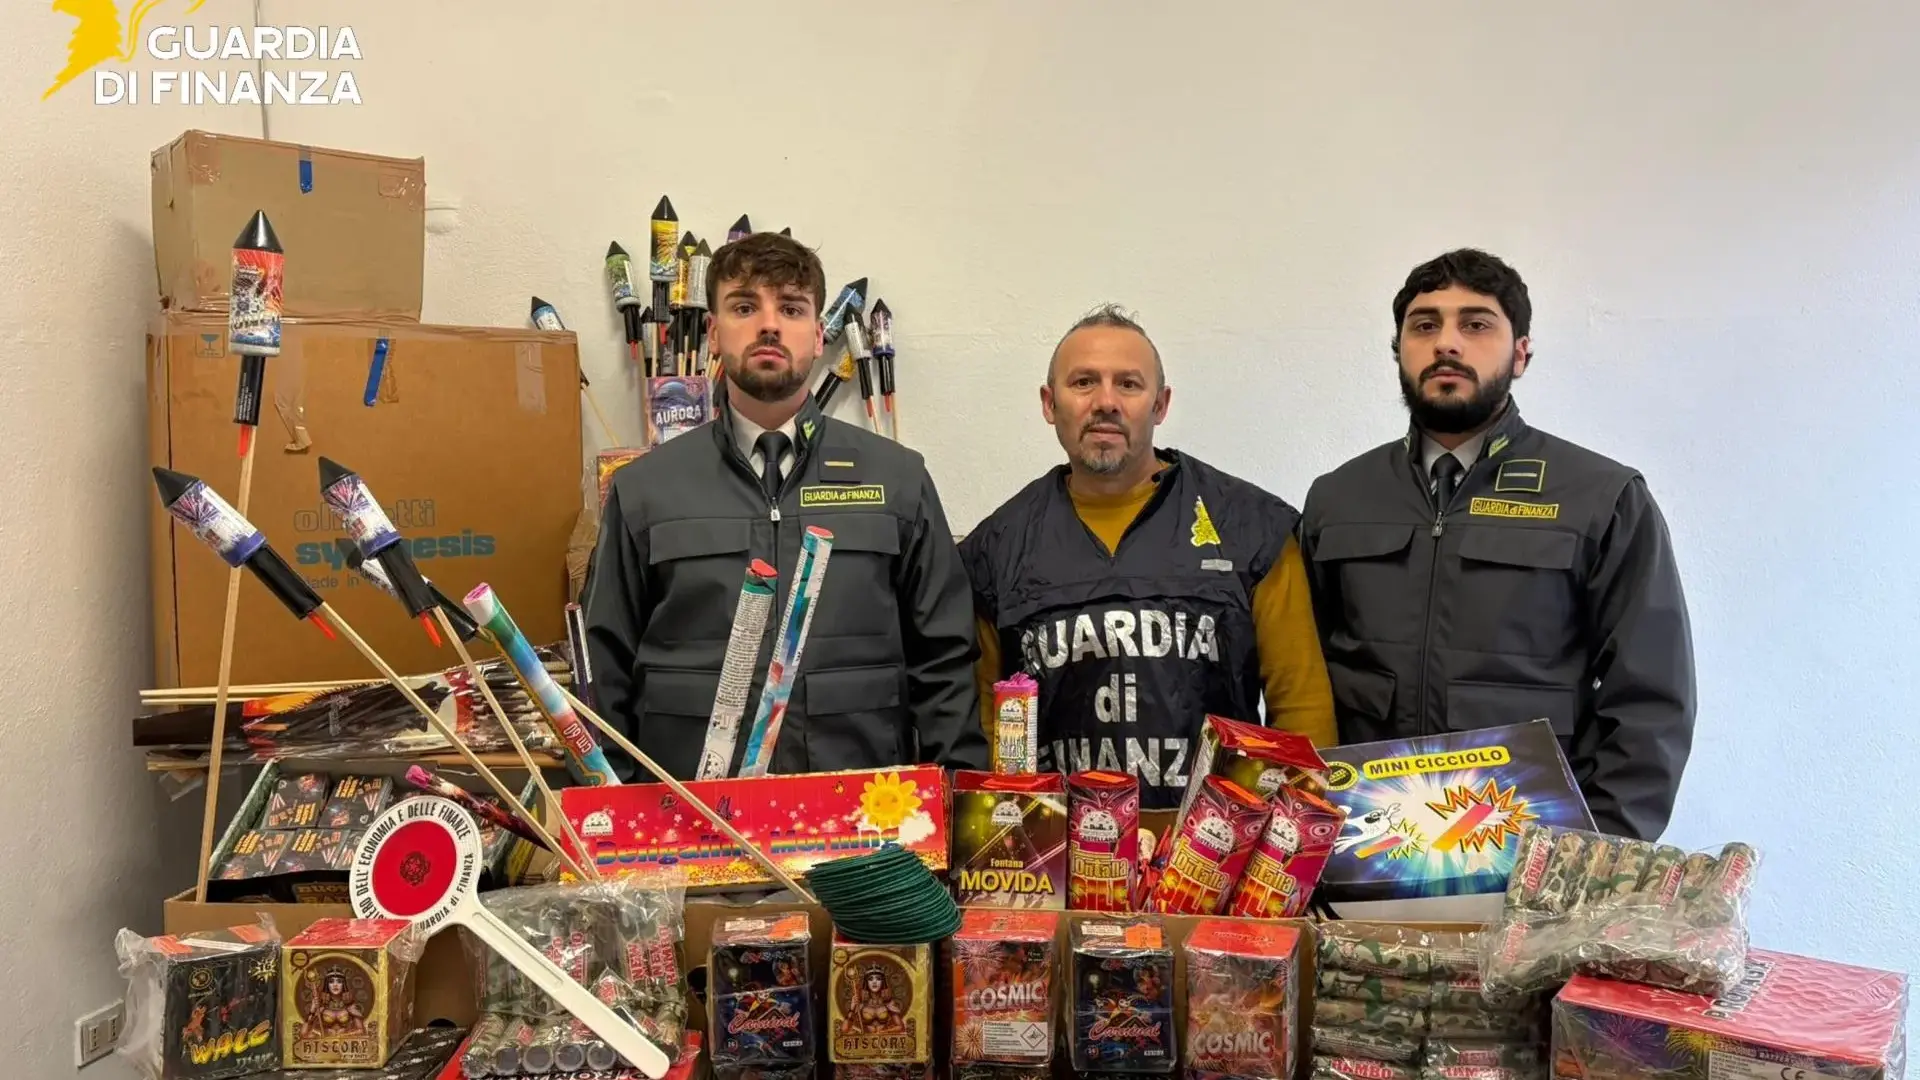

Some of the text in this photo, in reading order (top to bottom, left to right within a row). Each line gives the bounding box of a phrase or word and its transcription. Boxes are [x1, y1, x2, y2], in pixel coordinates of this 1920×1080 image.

[655, 404, 702, 426] AURORA
[804, 489, 881, 502] GUARDIA di FINANZA
[1473, 500, 1554, 516] GUARDIA di FINANZA
[293, 499, 436, 532] oltti
[295, 528, 496, 571] syesis
[306, 575, 338, 590] ade
[1094, 673, 1138, 723] di
[1369, 758, 1411, 776] MINI
[1414, 749, 1504, 770] CICCIOLO
[360, 816, 397, 866] ECONOMIA
[397, 808, 405, 822] E
[407, 802, 438, 819] DELLE
[438, 804, 472, 842] FINANZE
[990, 857, 1024, 869] Fontana
[450, 895, 460, 907] di
[456, 853, 475, 894] FINANZA
[961, 869, 1055, 895] MOVIDA
[628, 943, 645, 982] NEW
[968, 981, 1044, 1011] COSMIC
[1193, 1030, 1272, 1056] COSMIC
